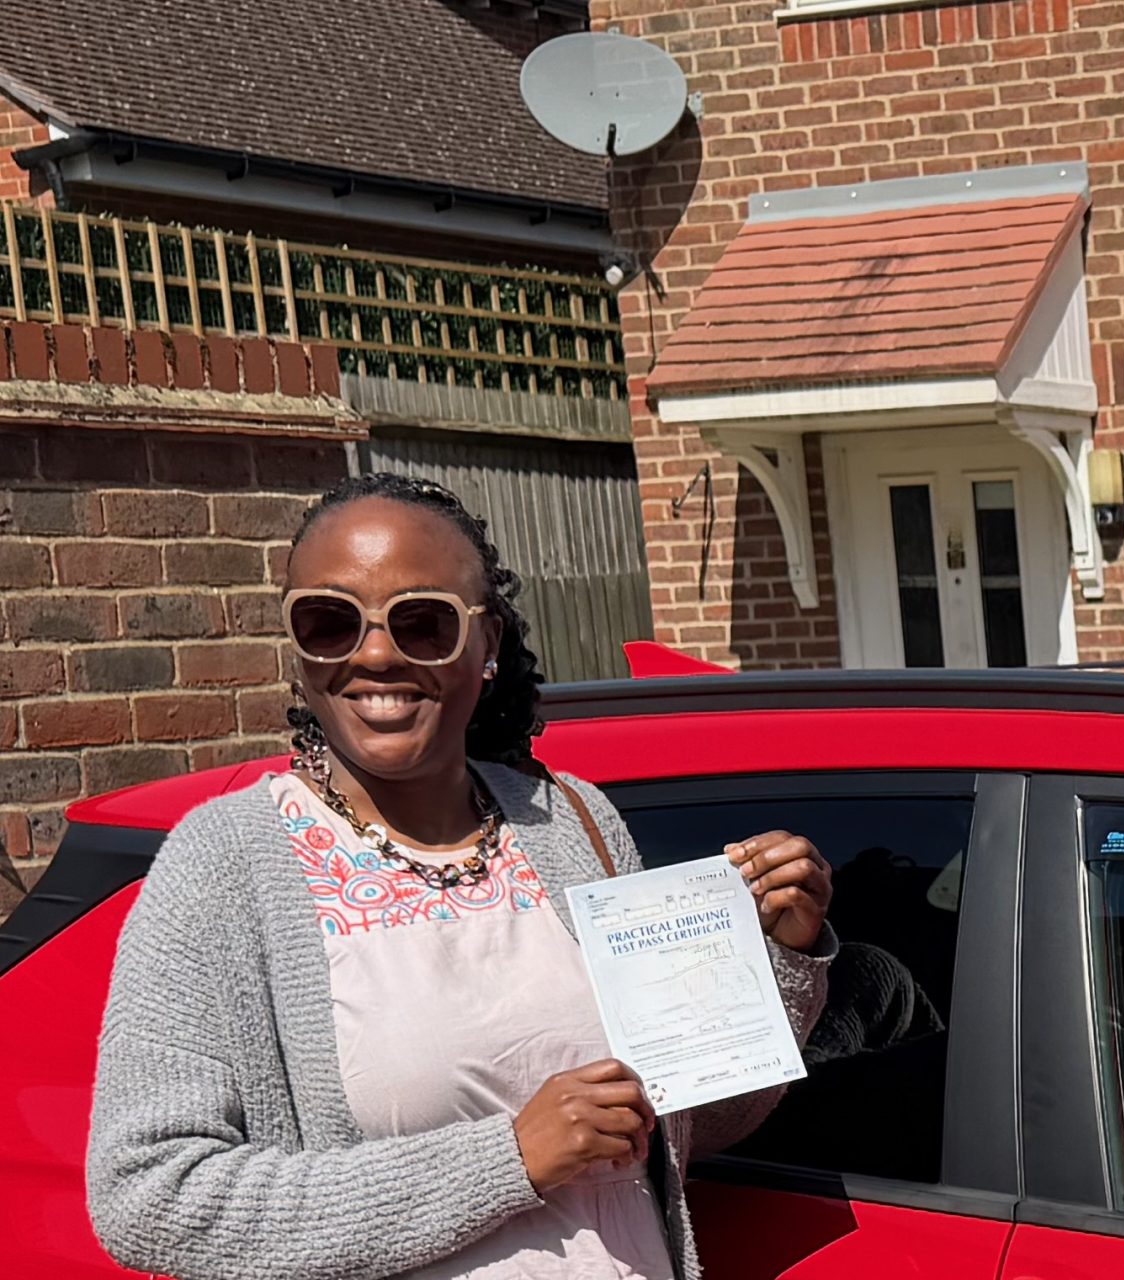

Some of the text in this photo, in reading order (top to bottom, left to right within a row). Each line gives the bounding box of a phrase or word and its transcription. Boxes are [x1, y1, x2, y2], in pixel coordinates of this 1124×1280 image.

[607, 906, 730, 945] PRACTICAL DRIVING
[611, 941, 636, 956] TEST
[638, 935, 665, 950] PASS
[666, 919, 734, 943] CERTIFICATE
